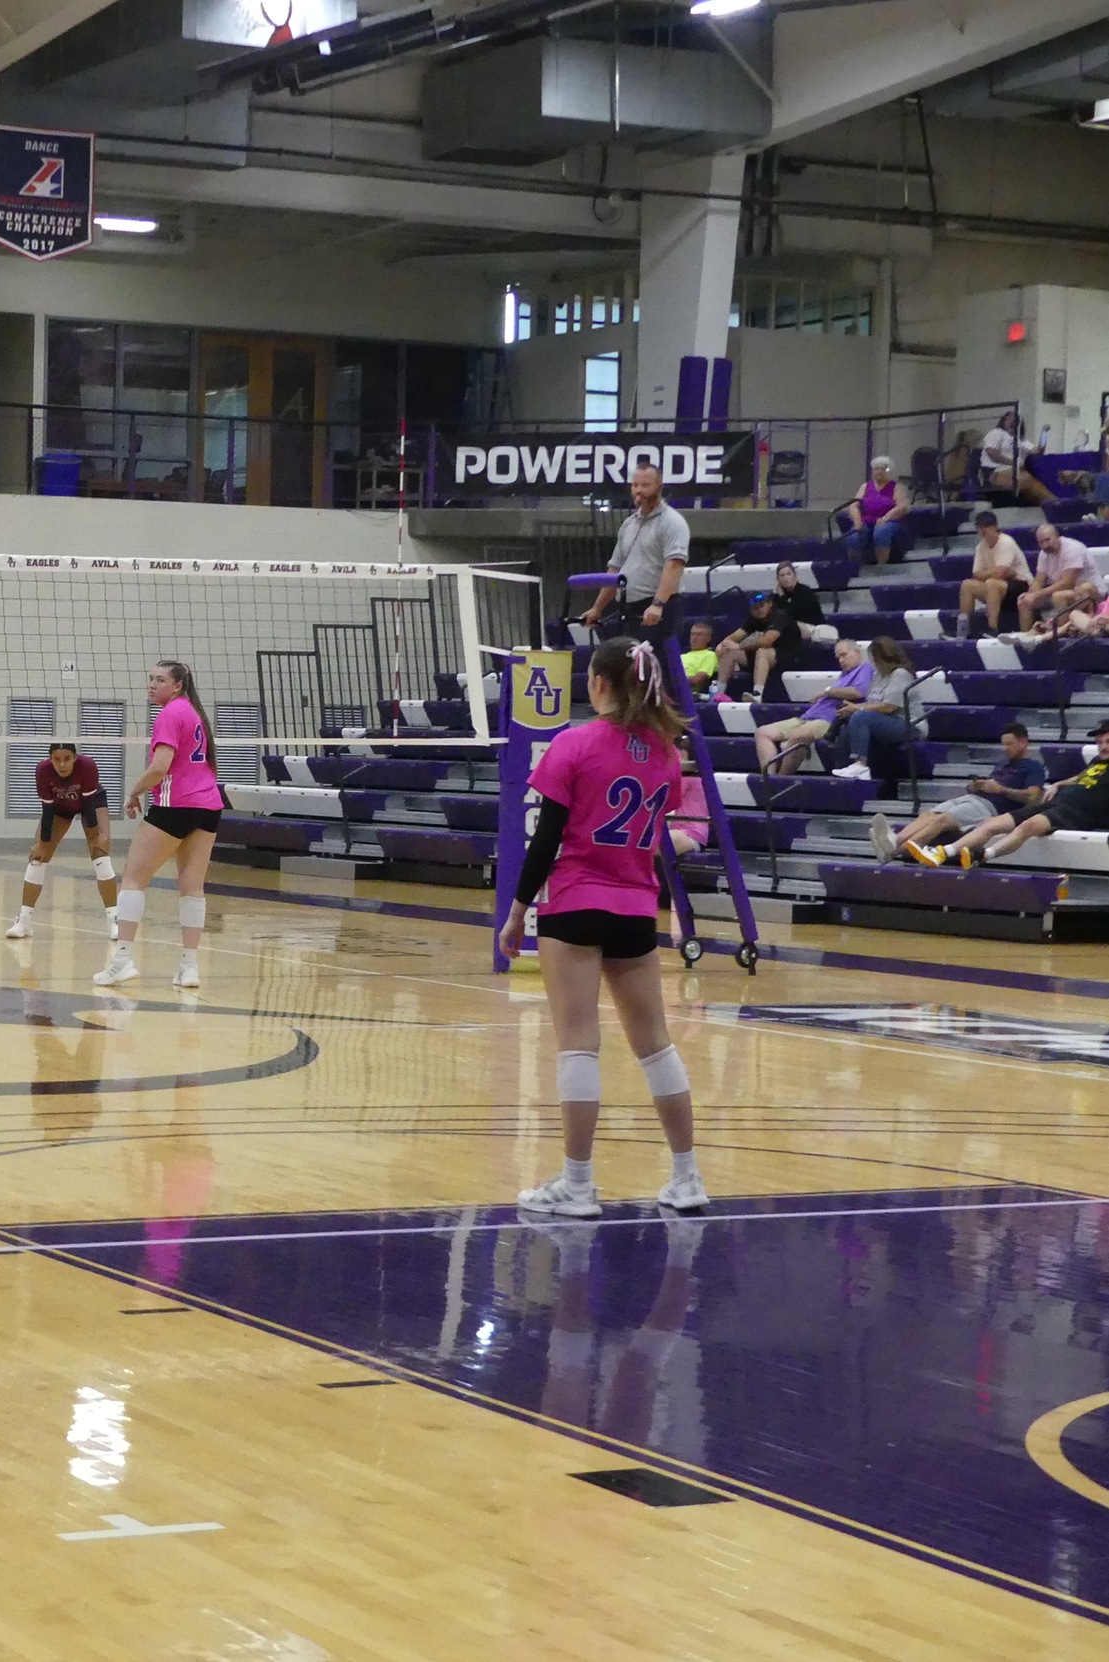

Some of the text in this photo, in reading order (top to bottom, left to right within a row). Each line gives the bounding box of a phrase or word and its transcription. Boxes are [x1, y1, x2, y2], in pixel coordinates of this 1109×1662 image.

[25, 140, 60, 154] DANCE
[6, 222, 74, 236] CHAMPION
[23, 238, 55, 252] 2017
[26, 557, 59, 567] EAGLES
[91, 559, 119, 568] AVILA
[149, 561, 183, 570] EAGLES
[212, 562, 239, 571] AVILA
[270, 563, 301, 572] EAGLES
[331, 565, 357, 574] AVILA
[524, 666, 562, 717] AU
[592, 775, 670, 850] 21
